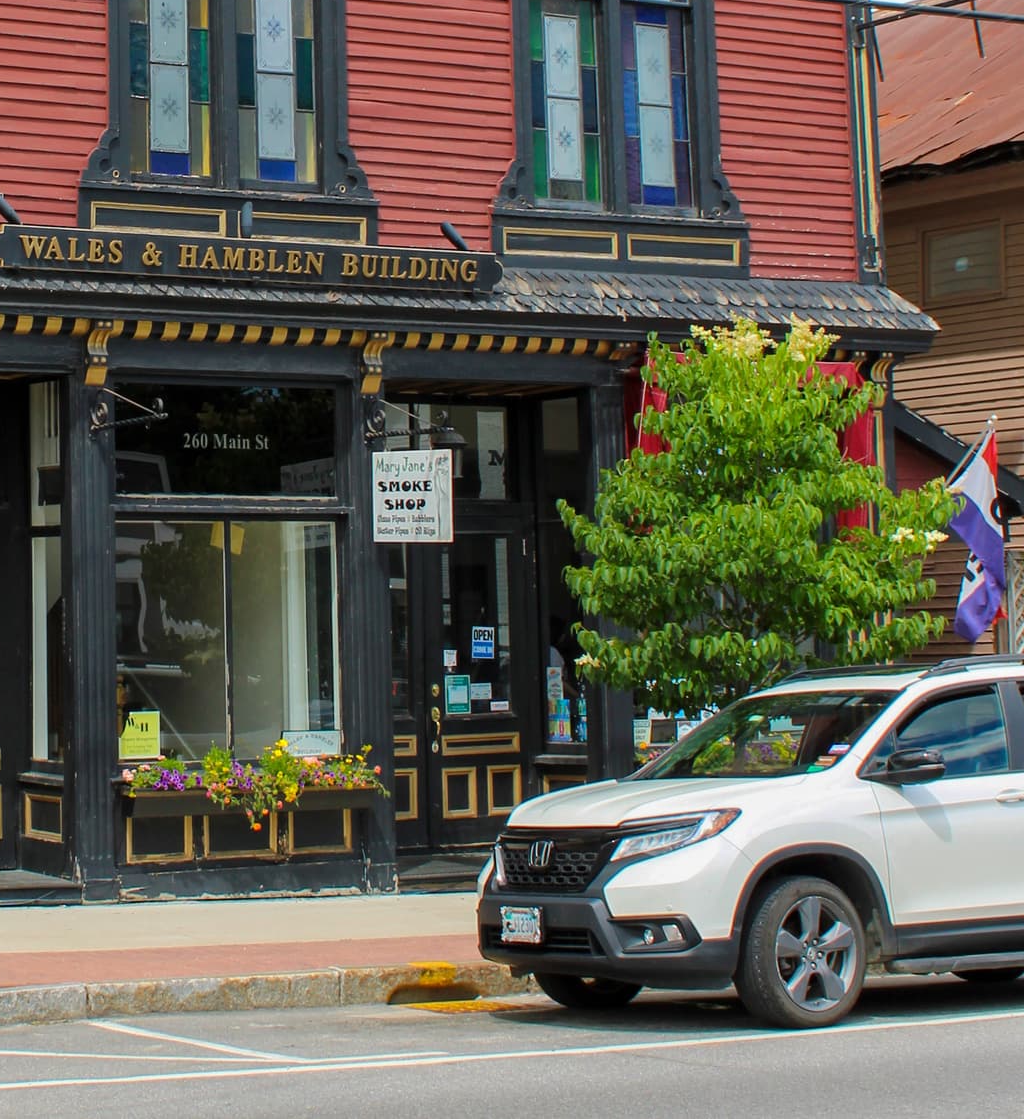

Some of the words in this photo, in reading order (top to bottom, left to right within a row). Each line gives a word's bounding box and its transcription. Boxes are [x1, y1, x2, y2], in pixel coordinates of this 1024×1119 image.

[19, 234, 124, 264] WALES
[141, 241, 163, 267] &
[178, 244, 325, 275] HAMBLEN
[340, 253, 478, 283] BUILDING
[183, 432, 209, 449] 260
[213, 433, 250, 450] Main
[256, 433, 270, 450] St
[376, 457, 400, 478] Mary
[402, 456, 433, 473] Jane's
[377, 480, 433, 493] SMOKE
[384, 498, 426, 511] SHOP
[473, 629, 493, 641] OPEN
